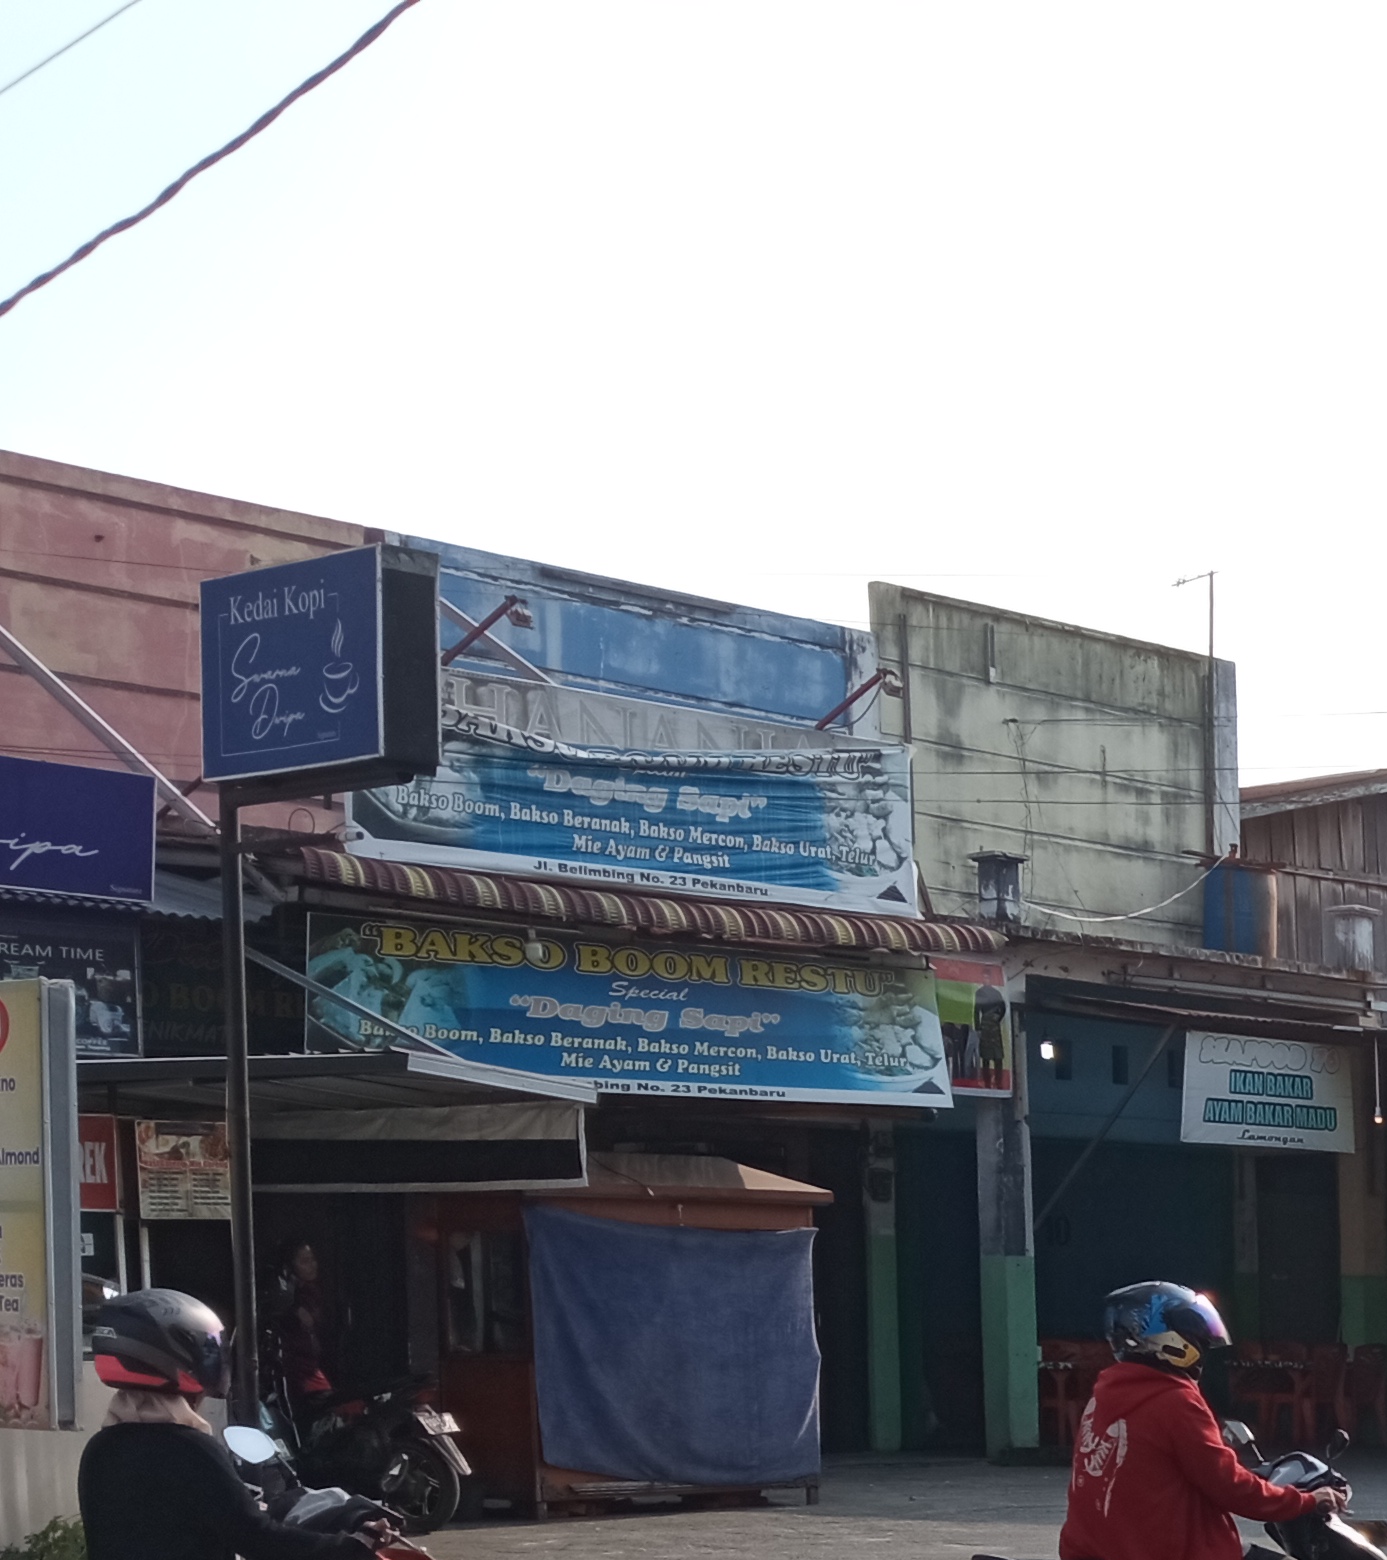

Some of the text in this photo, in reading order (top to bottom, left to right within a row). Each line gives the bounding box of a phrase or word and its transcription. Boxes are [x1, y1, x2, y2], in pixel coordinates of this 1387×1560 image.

[229, 578, 325, 625] Kedai Kopi
[395, 786, 877, 867] Bakso Boom, Bakso Beranak, Bakso Mercon, Bakso Urat, Telur
[571, 832, 731, 871] Mie Ayam & Pangsit
[557, 862, 636, 884] Belimbing
[639, 872, 665, 886] No.
[669, 875, 688, 888] 23
[691, 879, 769, 898] Pekanbaru
[58, 946, 105, 962] TIME
[573, 942, 731, 986] BOOM
[607, 980, 689, 1002] Special
[424, 1023, 484, 1045] Boom,
[489, 1027, 546, 1047] Bakso
[549, 1031, 633, 1053] Beranak,
[637, 1037, 689, 1056] Bakso
[694, 1040, 763, 1061] Mercon,
[766, 1046, 816, 1063] Bakso
[820, 1048, 862, 1067] Urat,
[864, 1052, 908, 1068] Telur
[560, 1052, 741, 1078] Mie Ayam & Pangsit
[636, 1083, 666, 1094] No.
[669, 1083, 692, 1094] 23
[696, 1085, 787, 1098] Pekanbaru
[1229, 1069, 1313, 1100] IKAN BAKAR
[1203, 1097, 1337, 1132] AYAM BAKAR MADU
[1236, 1129, 1304, 1146] Lamongan
